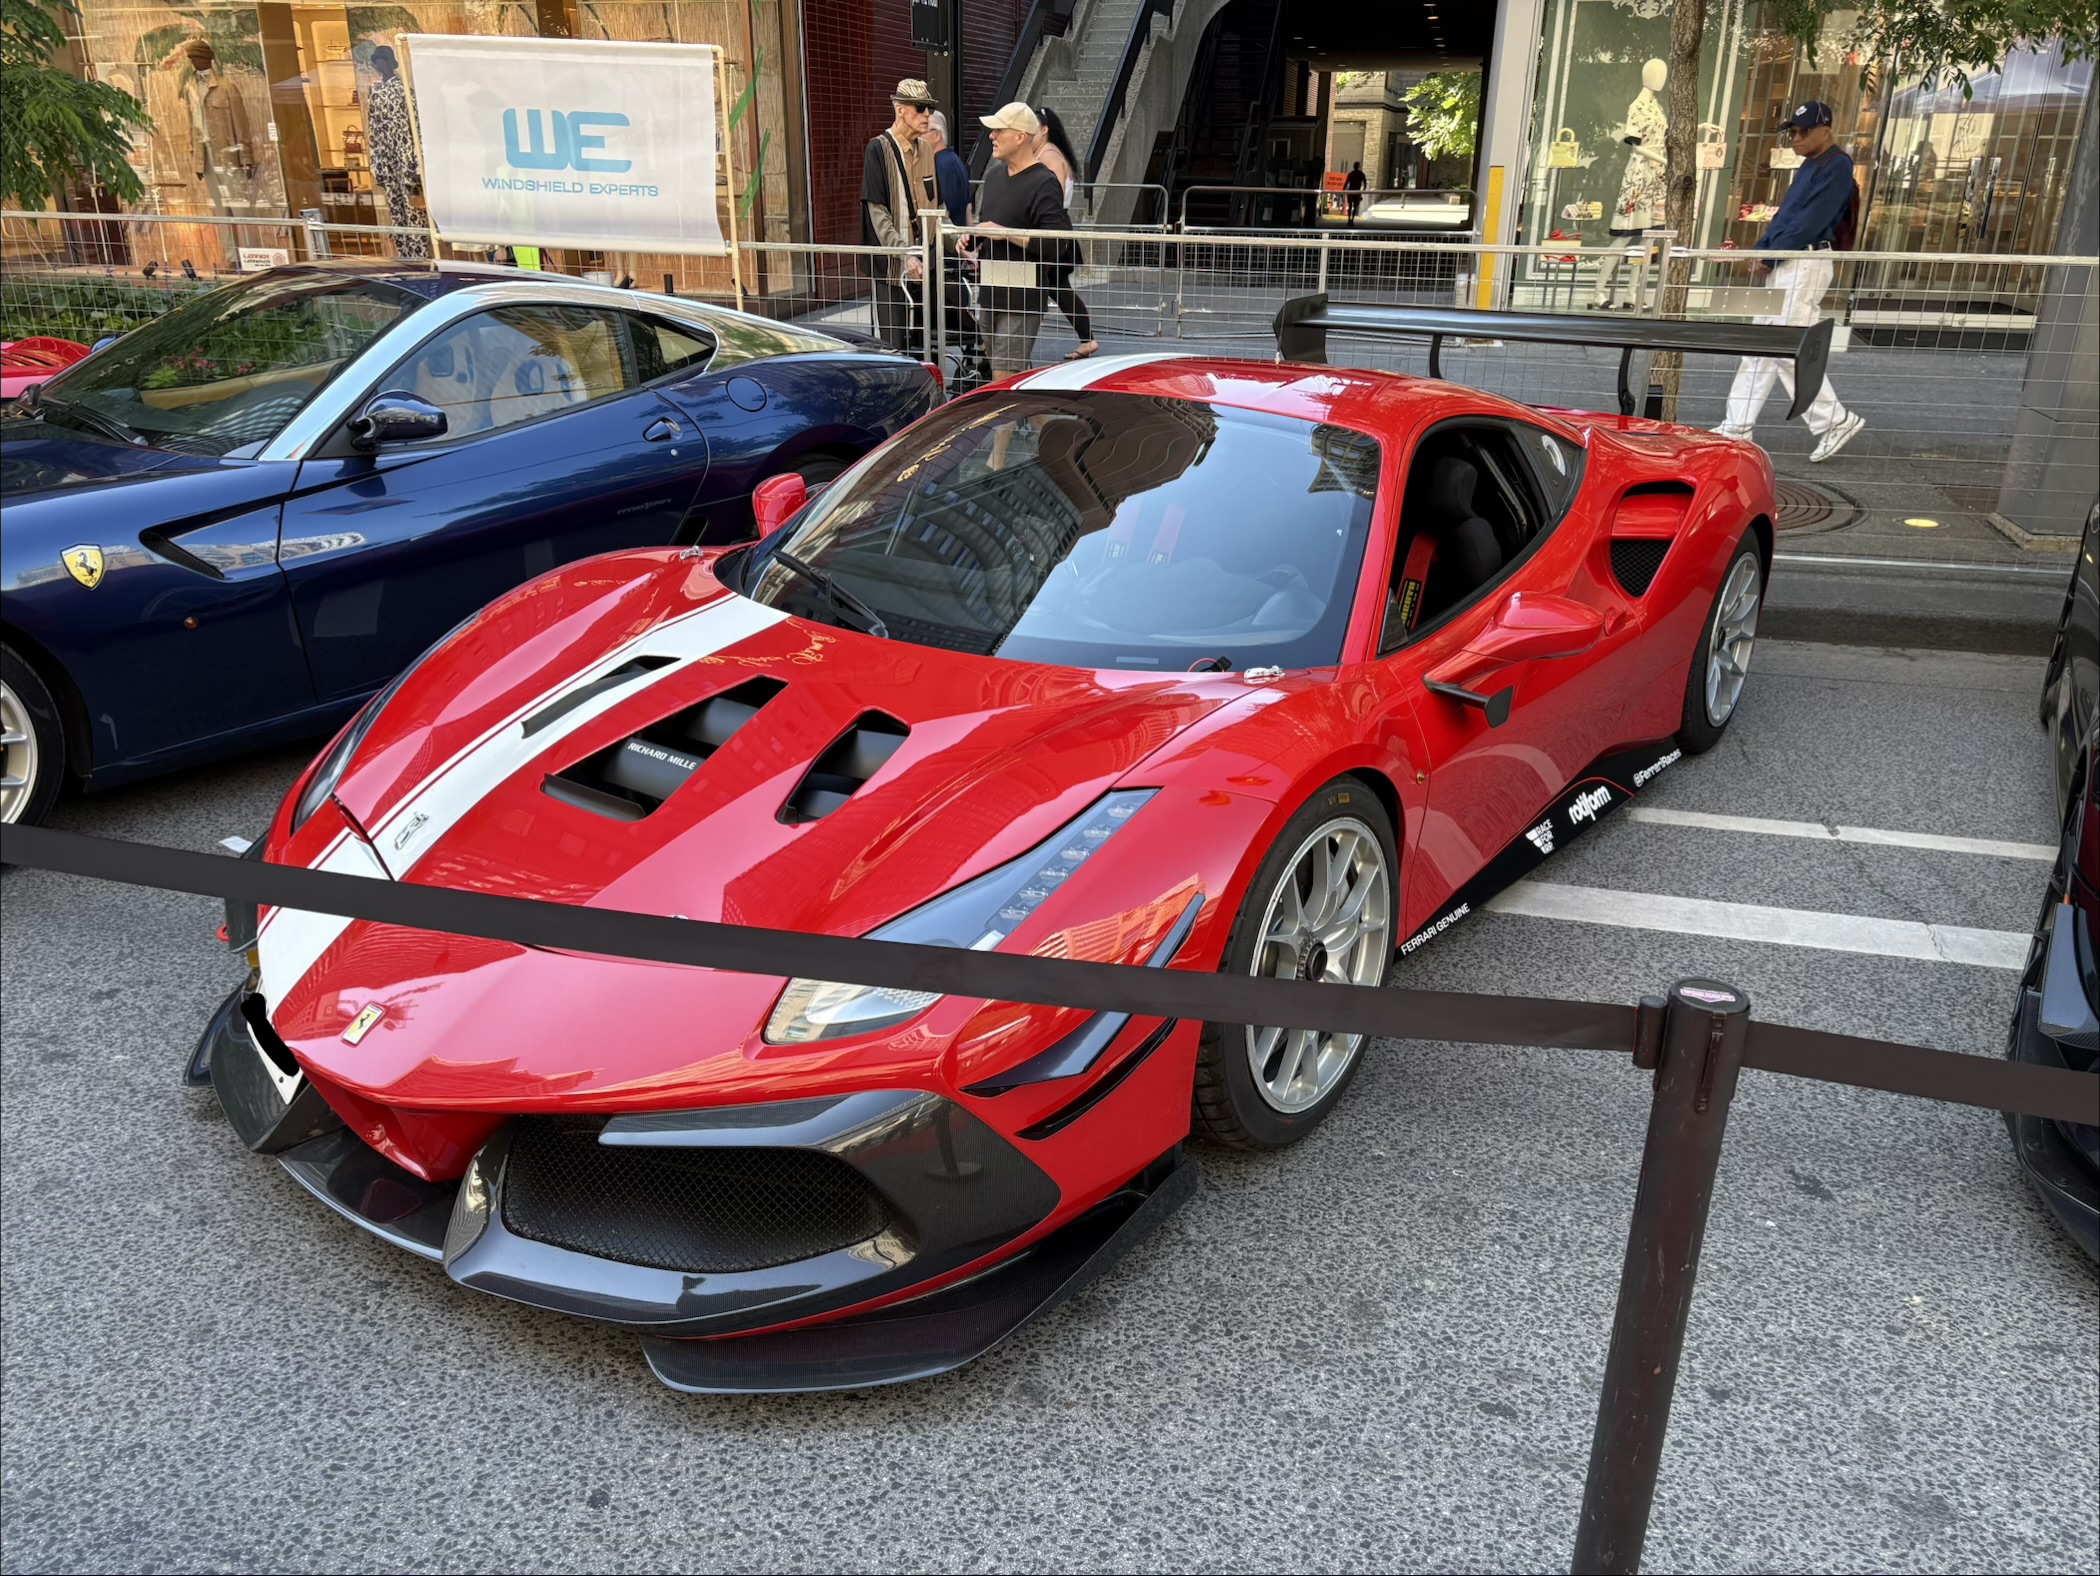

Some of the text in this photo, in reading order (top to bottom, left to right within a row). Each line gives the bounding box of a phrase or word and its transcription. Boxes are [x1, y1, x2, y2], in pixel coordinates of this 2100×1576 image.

[502, 108, 633, 174] WE
[482, 177, 659, 198] WINDSHIELD EXPERTS
[627, 742, 697, 770] RICHARD MILLE
[1633, 748, 1682, 787] @FerrariRaces
[1568, 785, 1612, 825] rotiform
[1535, 818, 1553, 836] RACE
[1541, 829, 1554, 845] FOR
[1400, 902, 1470, 956] FERRARI GENUINE
